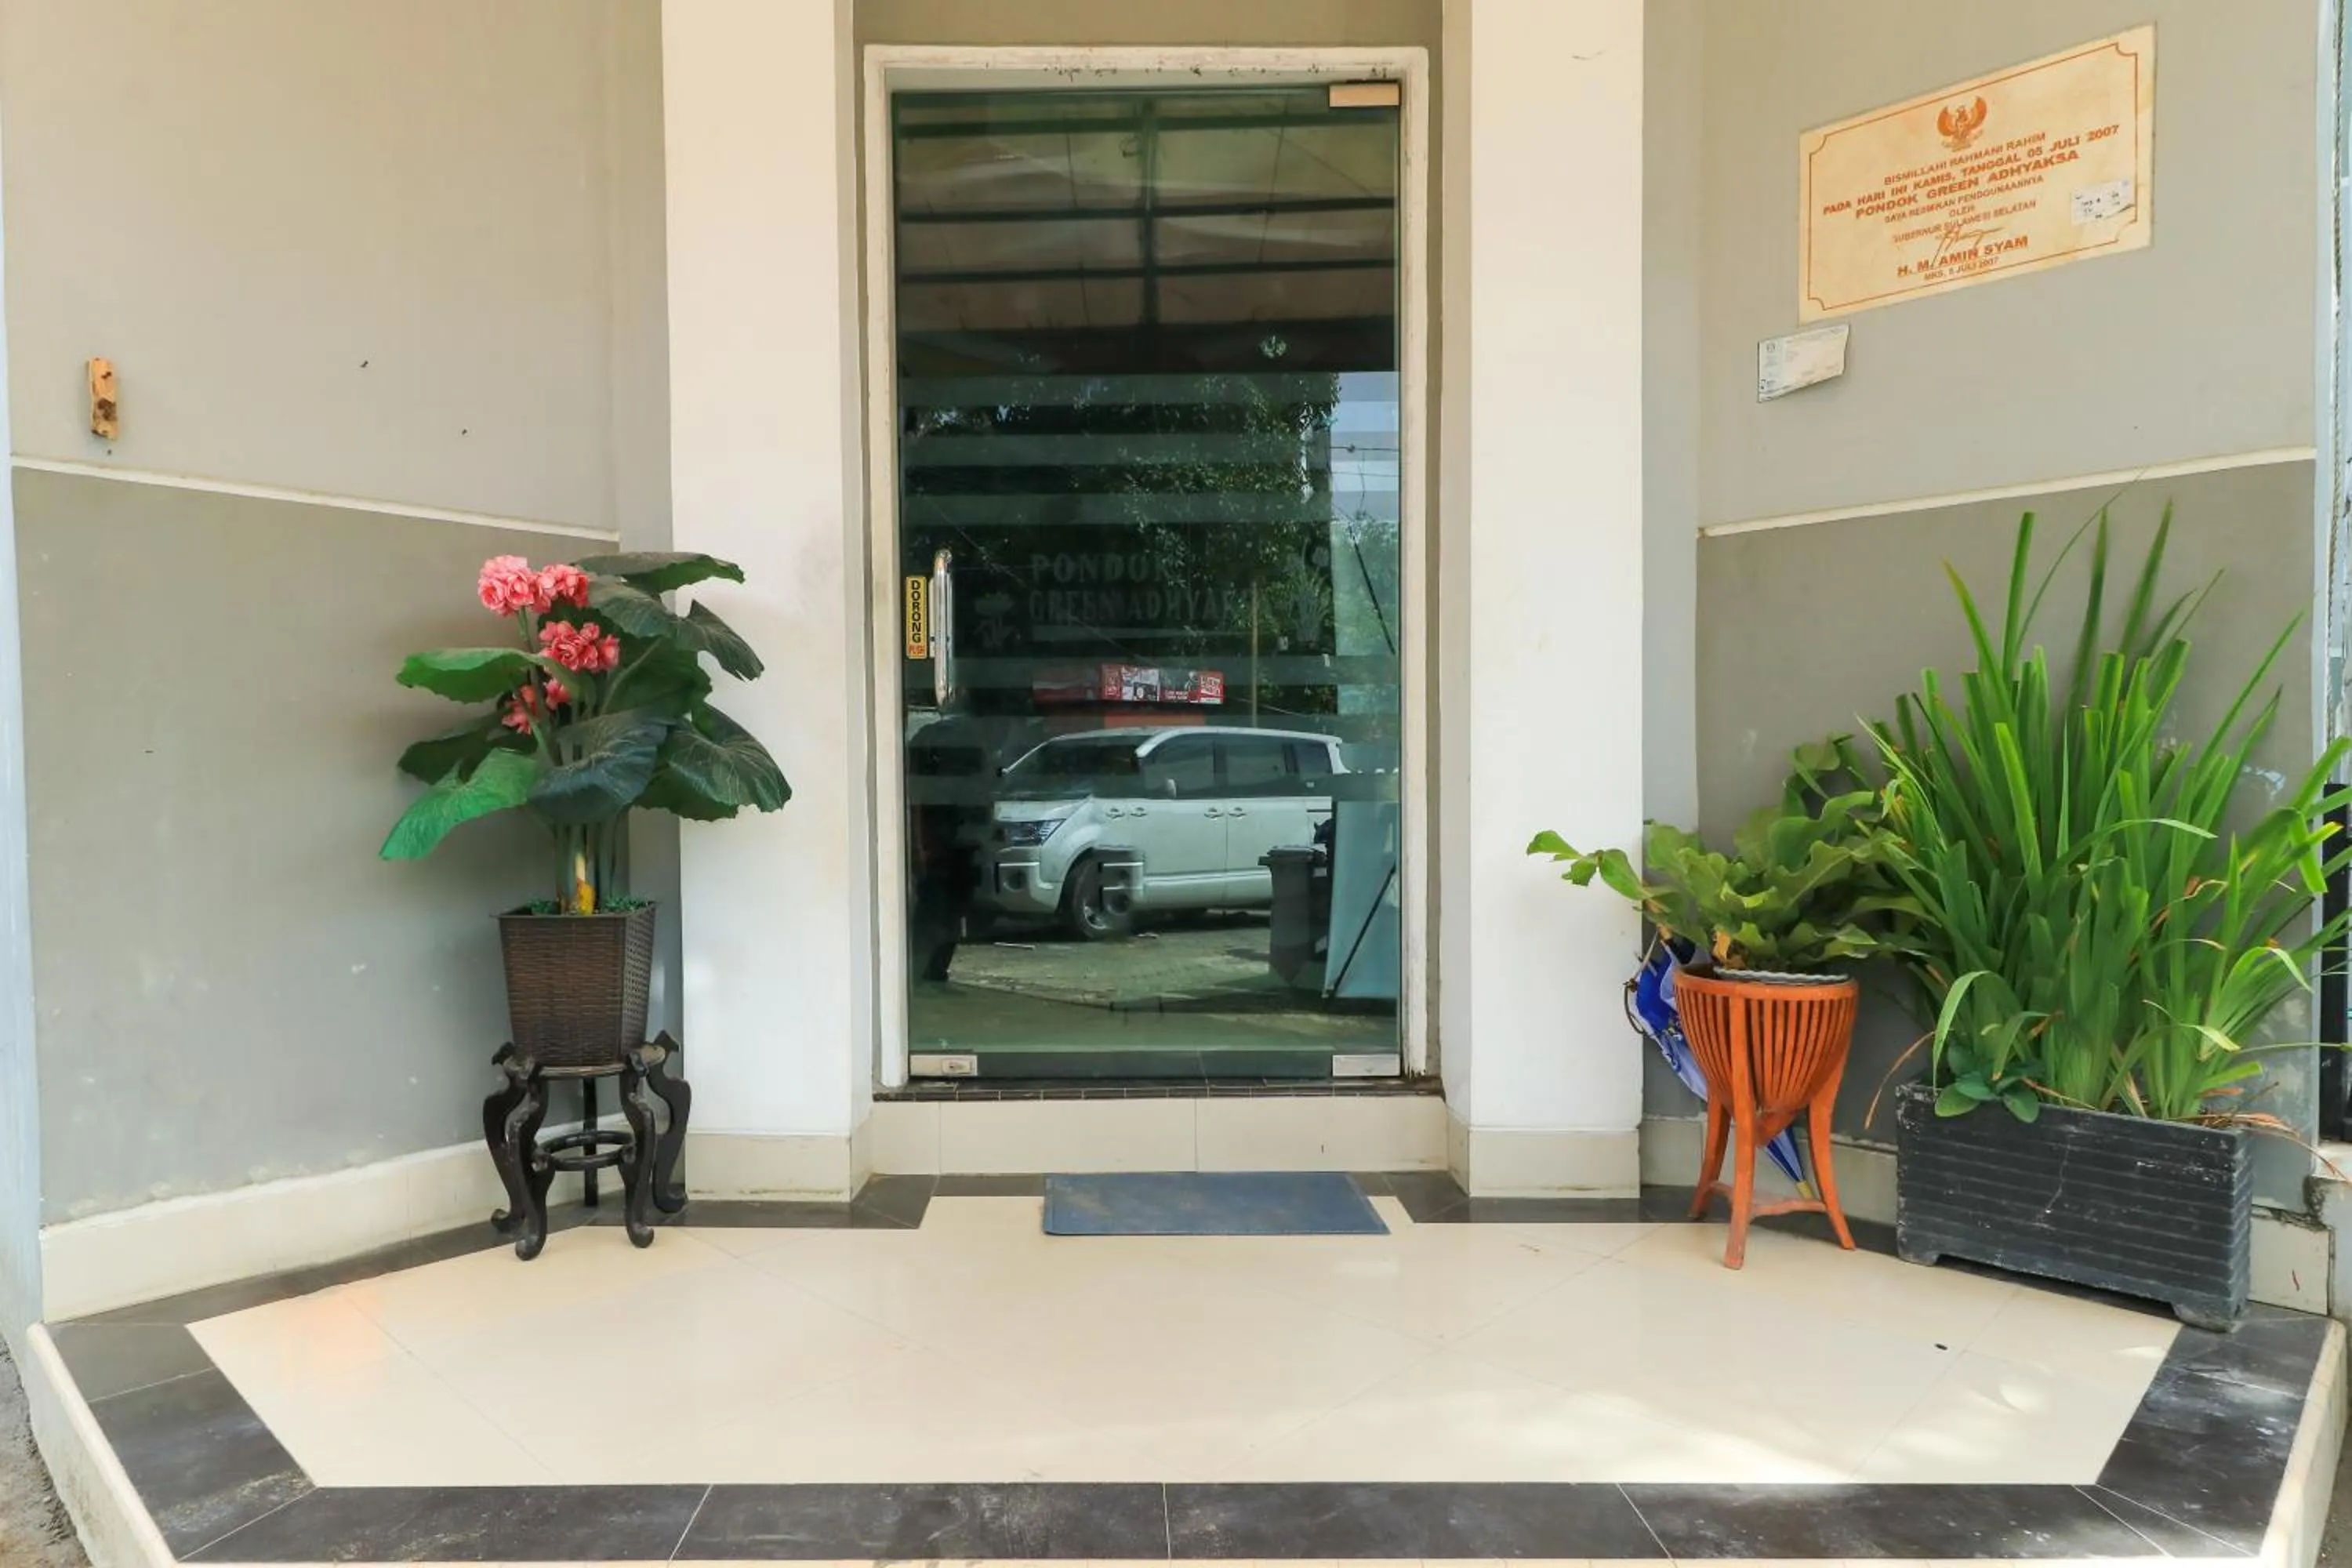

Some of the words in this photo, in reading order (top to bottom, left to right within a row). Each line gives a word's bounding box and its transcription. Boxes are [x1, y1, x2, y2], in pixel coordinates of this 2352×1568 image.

[1823, 200, 1852, 215] PADA
[1857, 191, 1886, 206] HARI
[1890, 184, 1907, 197] INI
[1962, 154, 2021, 176] TANGGAL
[2027, 147, 2043, 158] 05
[2049, 136, 2081, 152] JULI
[2086, 124, 2120, 143] 2007
[1856, 194, 1918, 220] PONDOK
[1926, 177, 1980, 199] GREEN
[1987, 150, 2080, 183] ADHYAKSA
[1884, 161, 1947, 186] BISMILLAHI
[1950, 144, 2003, 167] RAHMANI
[2006, 132, 2045, 151] RAHIM
[1949, 204, 1975, 217] OLEH
[1938, 248, 1979, 267] AMIN
[1984, 235, 2028, 256] SYAM
[912, 579, 922, 644] DORONG
